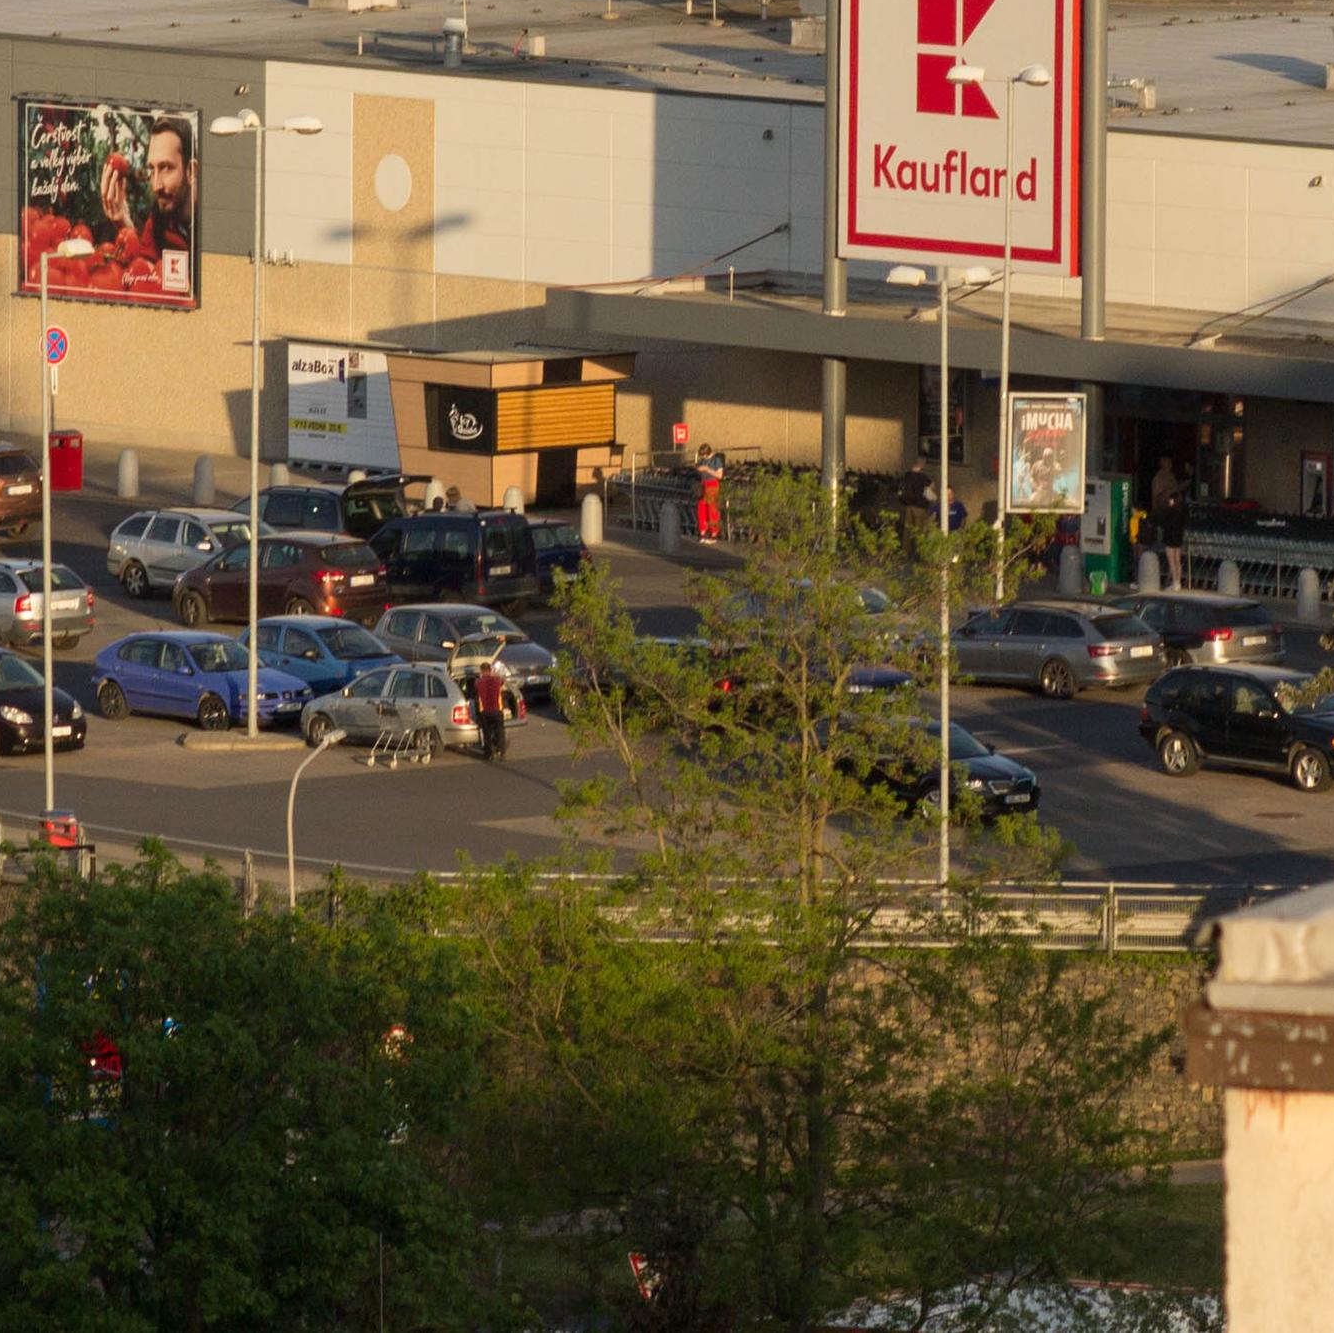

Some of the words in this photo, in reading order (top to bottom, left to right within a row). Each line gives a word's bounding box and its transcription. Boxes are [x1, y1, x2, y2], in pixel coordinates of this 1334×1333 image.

[31, 113, 87, 150] Čerstvost
[873, 143, 1037, 202] Kaufland
[291, 358, 335, 375] alzaBox
